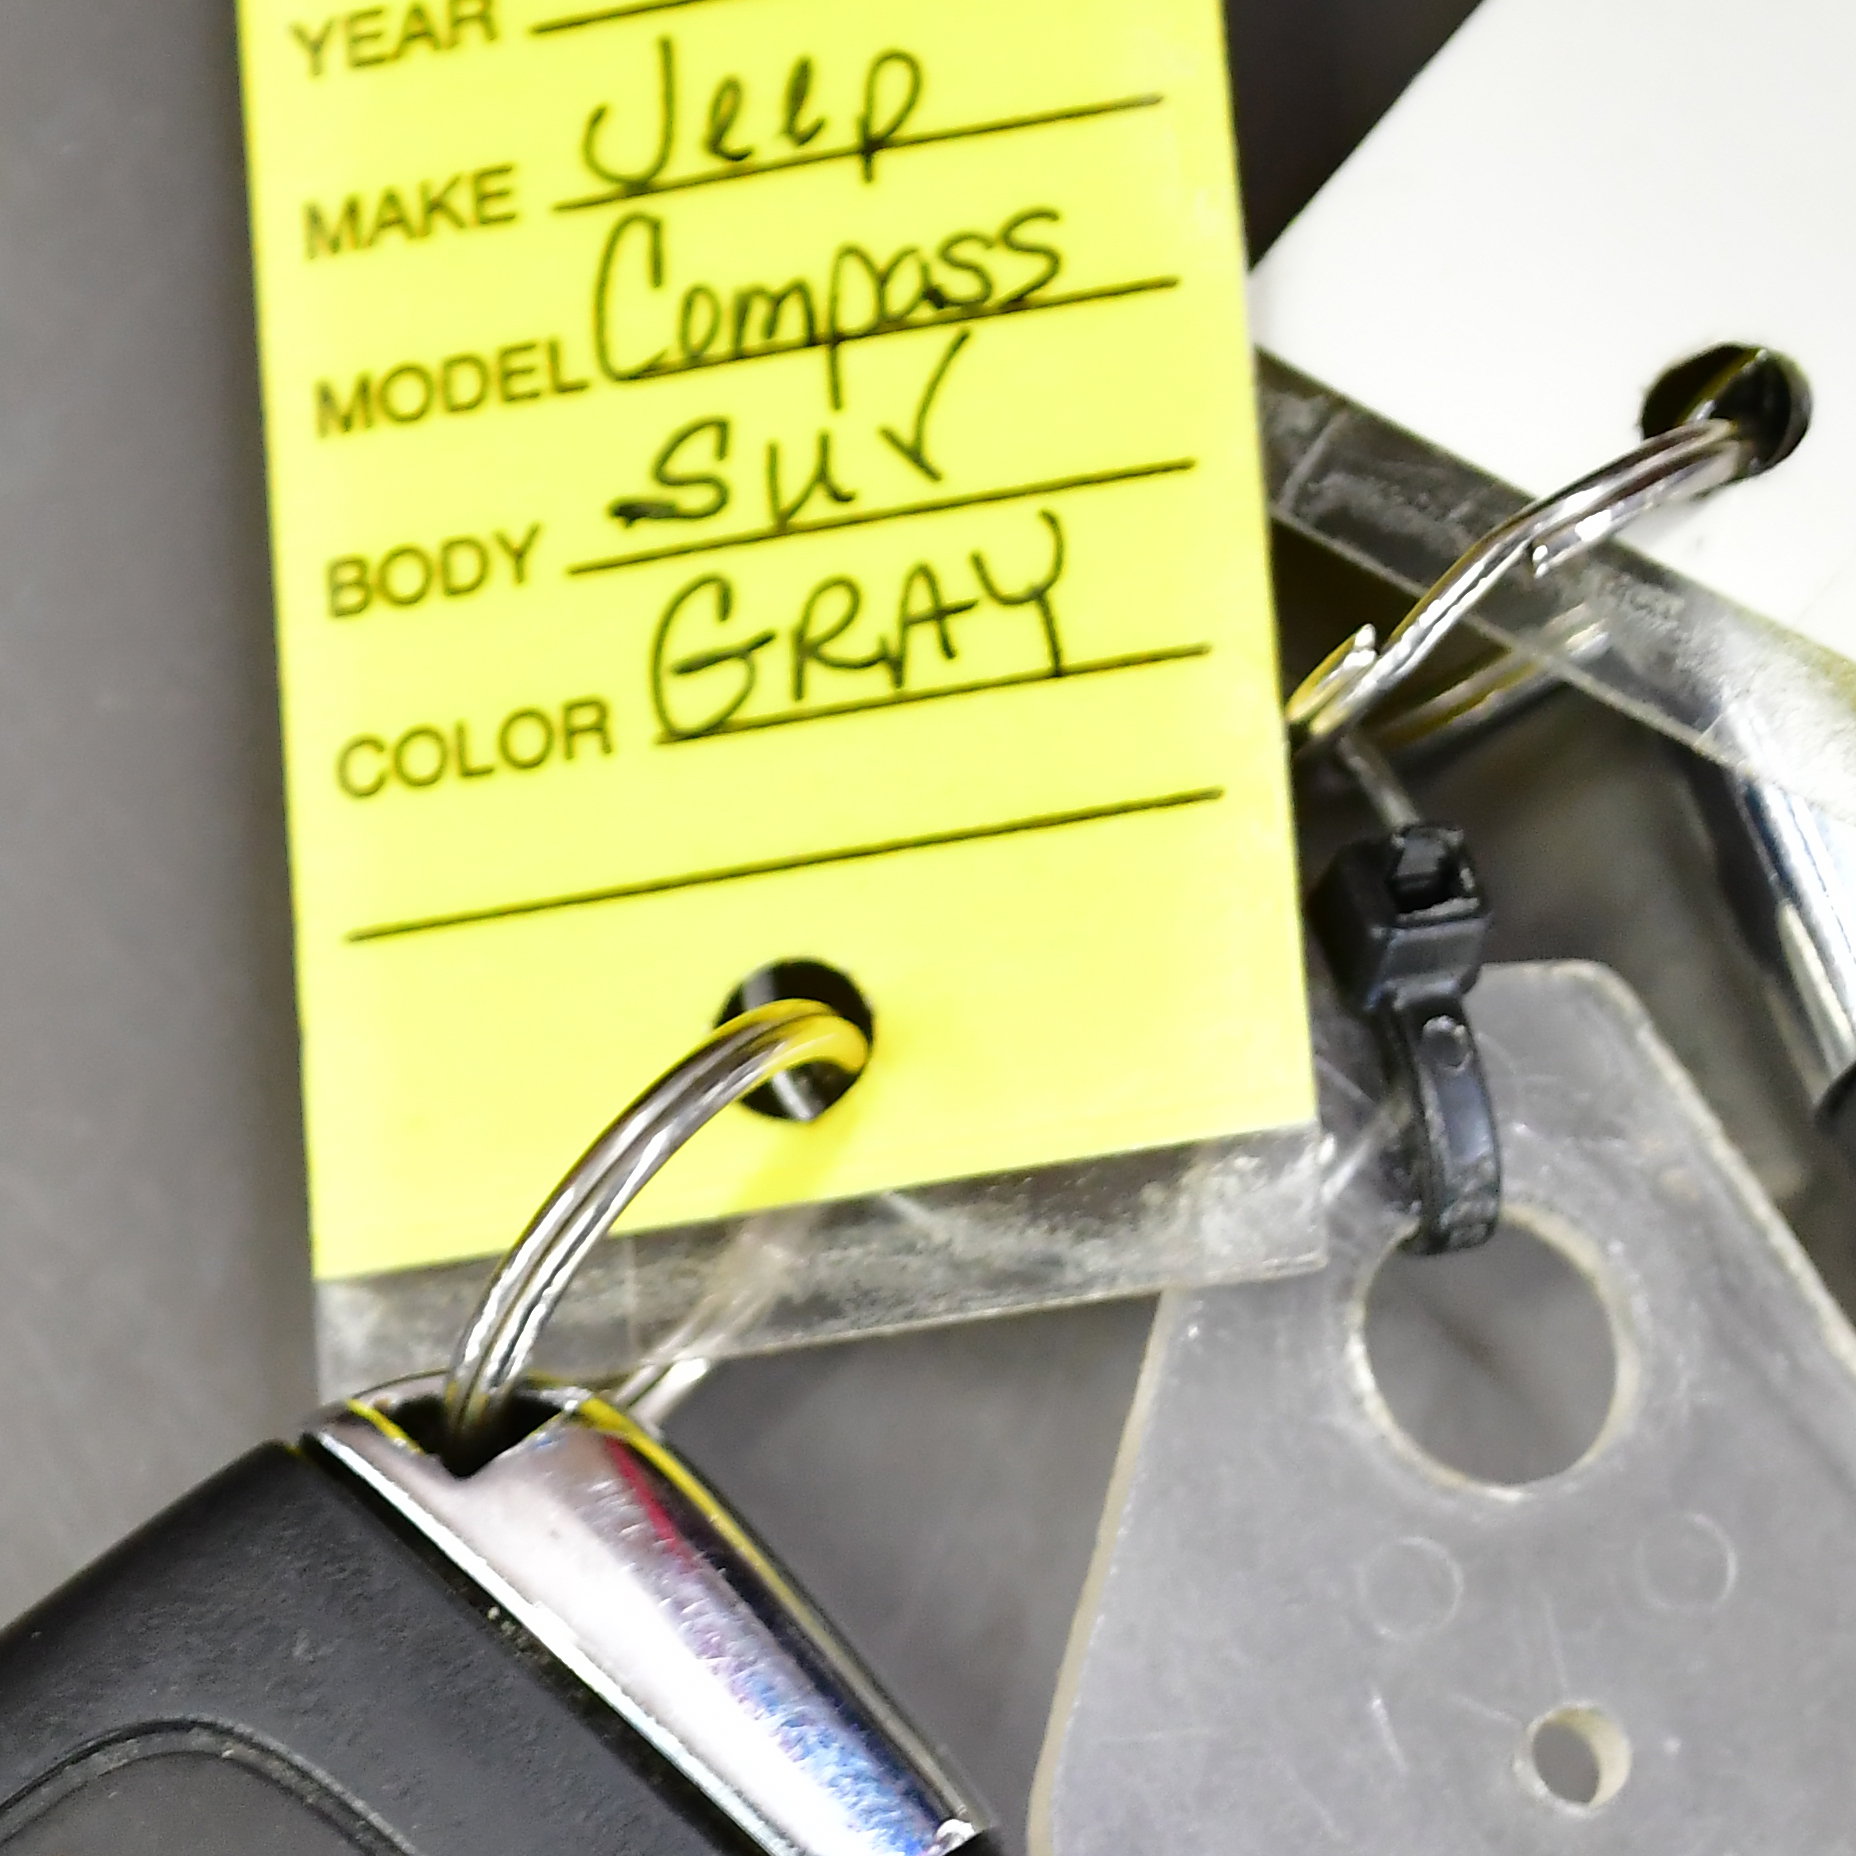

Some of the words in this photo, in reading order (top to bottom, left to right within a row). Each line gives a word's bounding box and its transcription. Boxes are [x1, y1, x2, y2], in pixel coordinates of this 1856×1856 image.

[290, 0, 499, 77] YEAR
[582, 36, 922, 192] Jeep
[304, 163, 517, 259] MAKE
[593, 211, 1065, 410] Compass
[315, 340, 587, 437] MODEL
[326, 525, 542, 617] BODY
[651, 510, 1066, 744] GRAY
[336, 698, 612, 800] COLOR
